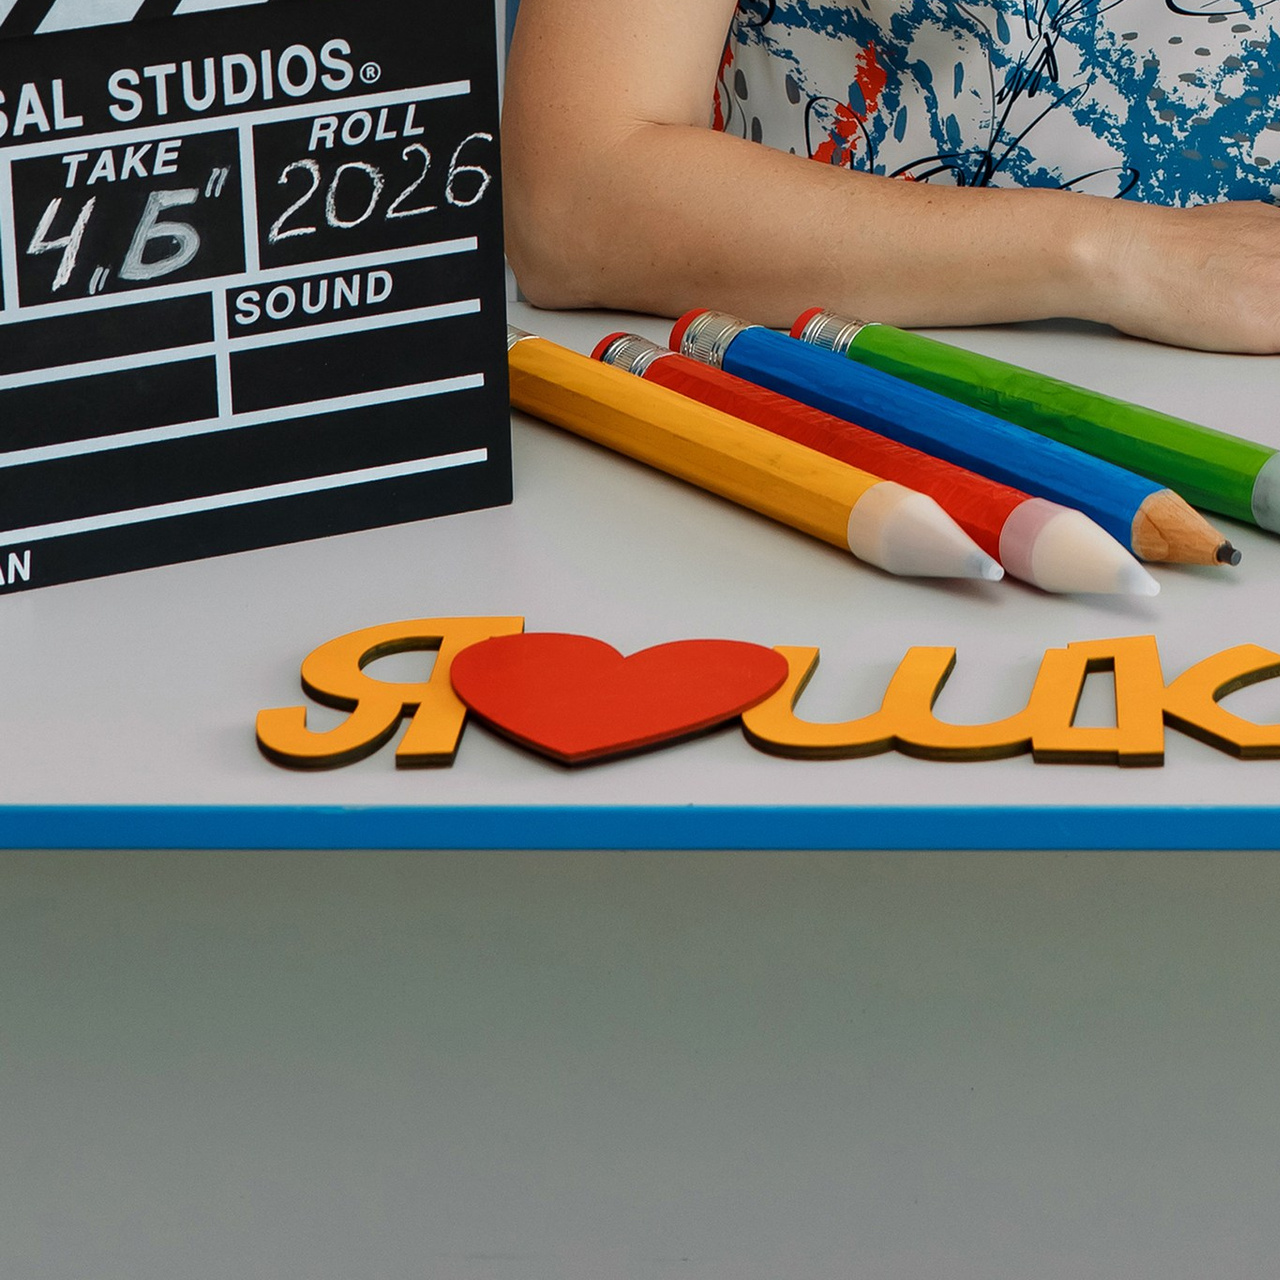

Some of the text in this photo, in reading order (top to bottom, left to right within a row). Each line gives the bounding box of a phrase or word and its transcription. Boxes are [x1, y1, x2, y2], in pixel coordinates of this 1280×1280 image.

[0, 78, 84, 139] AL
[308, 104, 425, 151] ROLL
[62, 140, 183, 189] TAKE
[268, 132, 493, 244] 2026
[234, 270, 393, 326] SOUND
[0, 549, 31, 586] N
